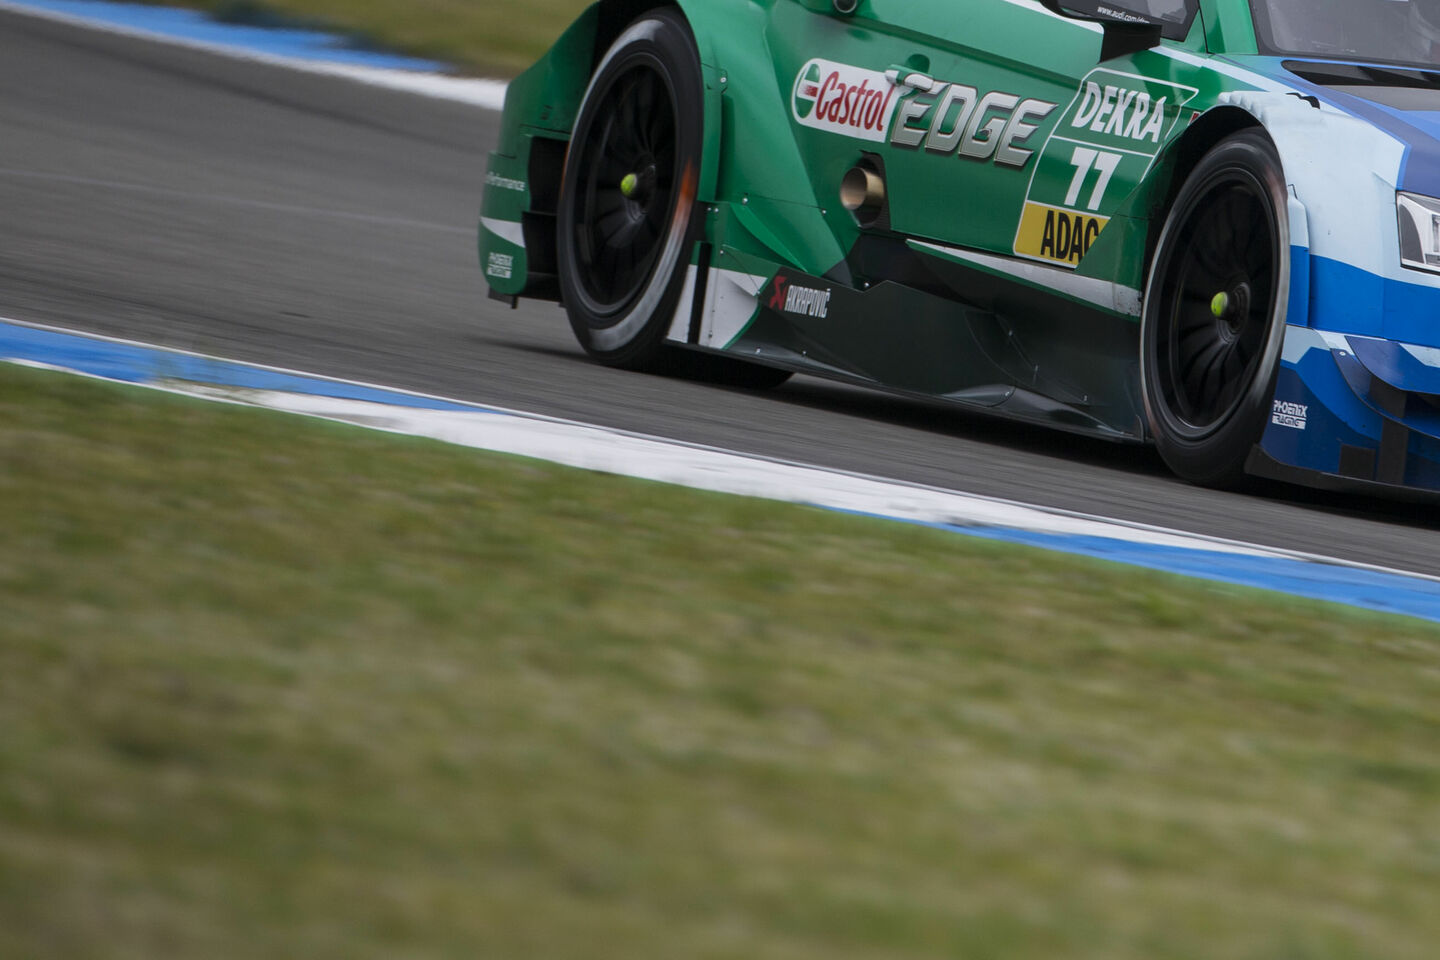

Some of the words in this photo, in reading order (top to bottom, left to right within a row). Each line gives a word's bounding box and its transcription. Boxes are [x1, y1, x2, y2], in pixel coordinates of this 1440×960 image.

[815, 71, 896, 132] Castrol
[890, 80, 1059, 167] EDGE
[1071, 81, 1167, 143] DEKRA
[1040, 210, 1099, 263] ADAC
